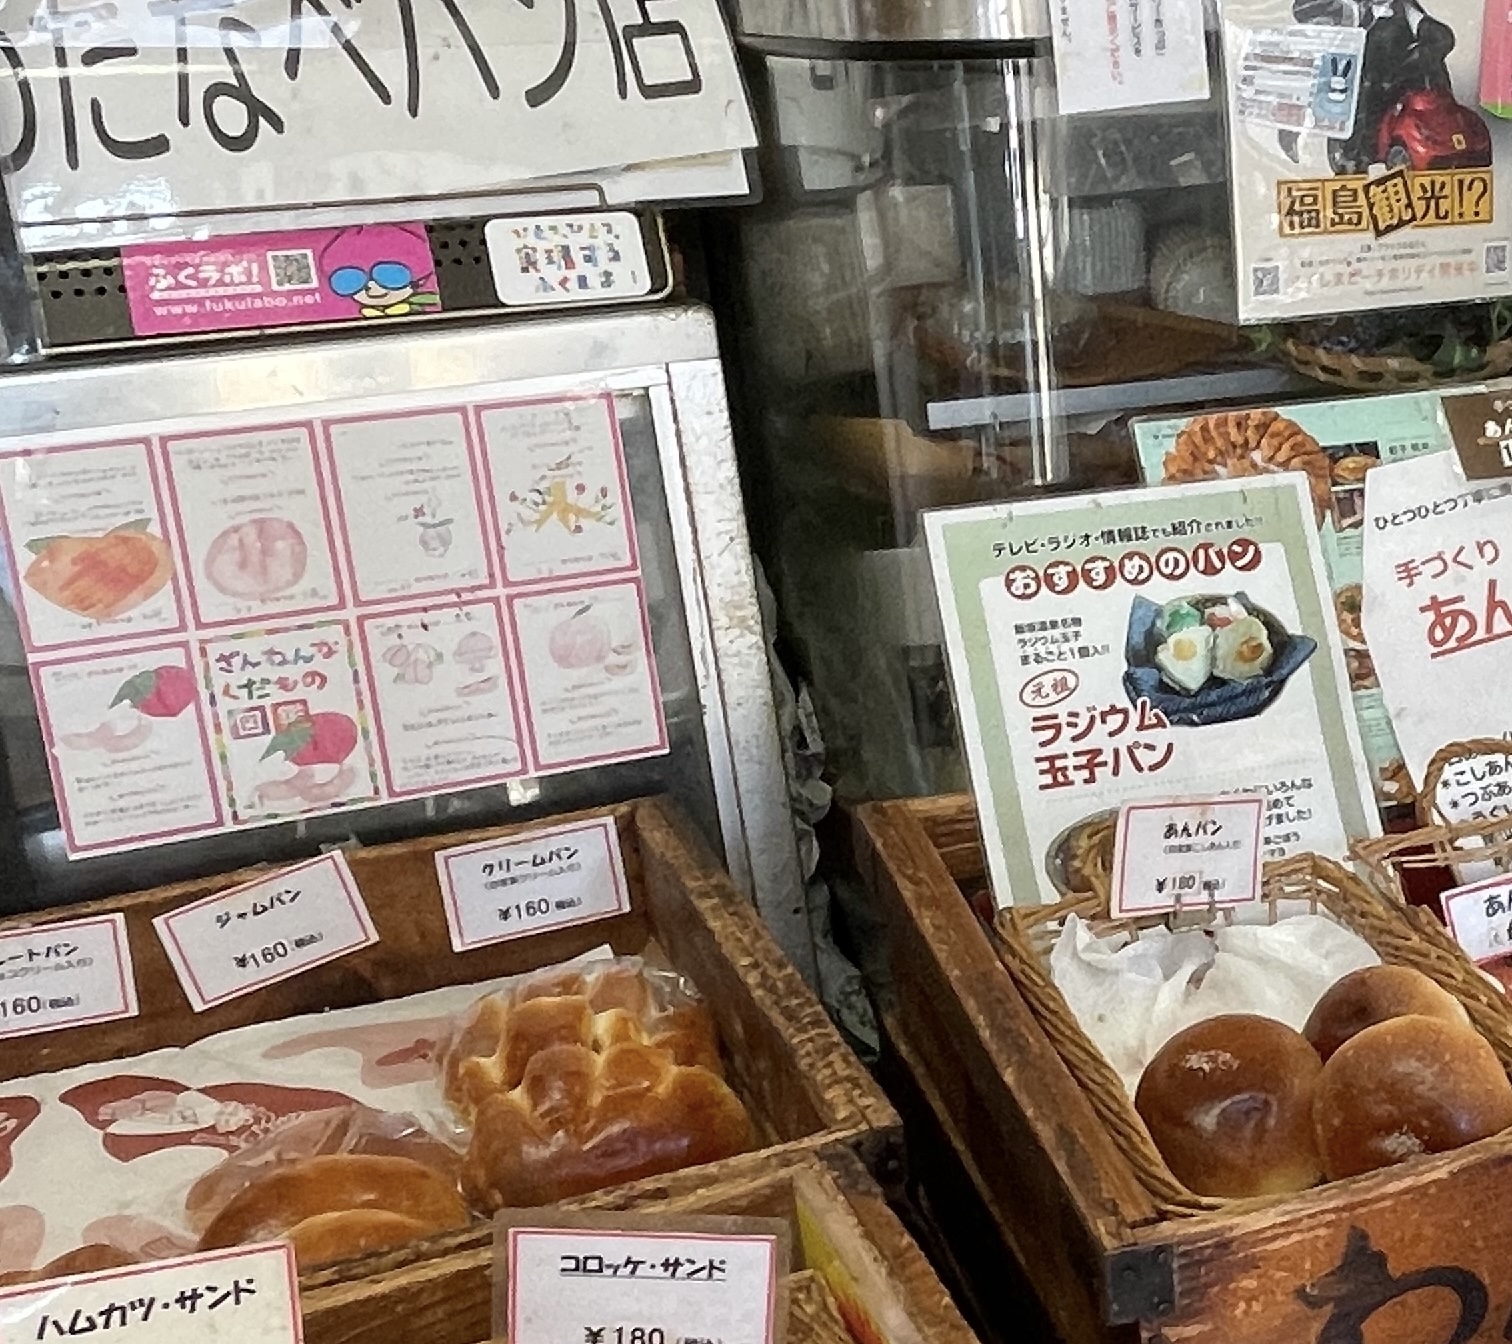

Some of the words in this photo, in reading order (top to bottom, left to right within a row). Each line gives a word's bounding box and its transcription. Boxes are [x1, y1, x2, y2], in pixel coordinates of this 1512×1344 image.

[1284, 172, 1490, 233] 福島観光!?
[149, 262, 260, 289] ふくラボ!
[153, 292, 322, 317] www.fukulabo.net
[1006, 539, 1262, 600] おすすめのパン
[1394, 538, 1501, 588] 手づくり
[223, 669, 329, 701] くだもの
[1031, 699, 1168, 748] ラジウム
[1034, 741, 1174, 791] 玉子パン
[1163, 819, 1223, 840] あんパン
[482, 846, 579, 876] クリームパン
[216, 888, 302, 929] ジャムパン
[498, 897, 549, 921] ¥160
[234, 941, 290, 967] ¥160
[560, 1255, 727, 1280] コロッケ・サンド
[36, 1277, 258, 1341] ハムカツ・サンド
